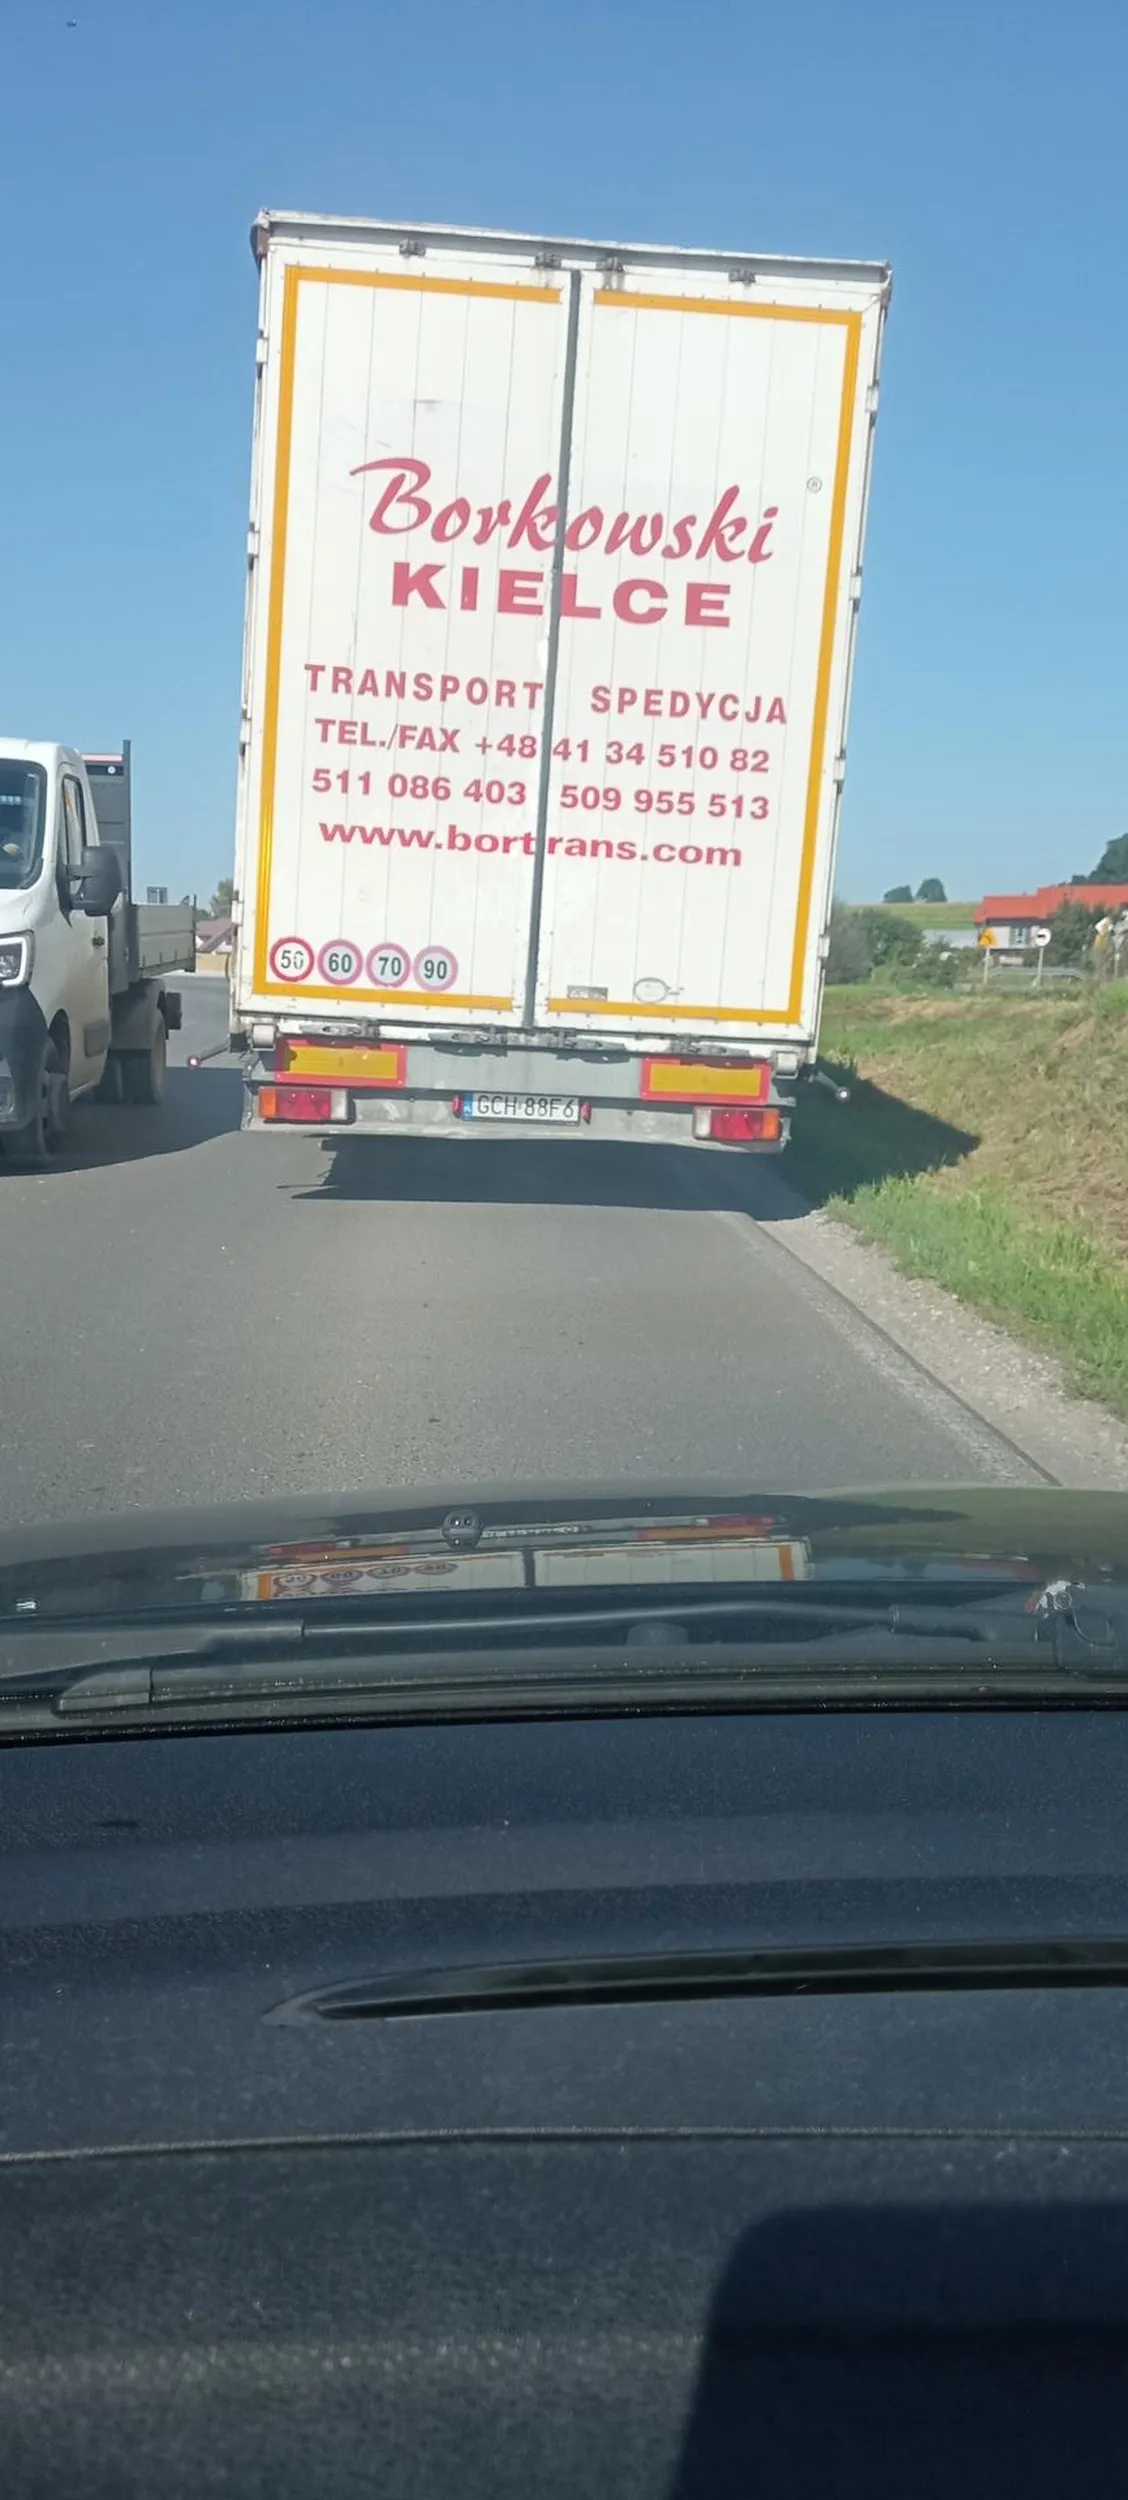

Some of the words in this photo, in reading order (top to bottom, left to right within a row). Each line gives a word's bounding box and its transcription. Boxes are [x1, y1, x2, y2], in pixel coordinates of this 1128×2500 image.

[350, 456, 779, 564] Borkowski
[391, 561, 731, 628] KIELCE
[304, 663, 544, 710] TRANSPORT
[590, 685, 788, 725] SPEDYCJA
[314, 717, 461, 753] TEL./FAX
[474, 734, 538, 760] +48
[552, 737, 589, 763] 41
[605, 740, 646, 766] 34
[656, 744, 720, 770] 510
[729, 748, 770, 774] 82
[311, 768, 372, 796] 511
[387, 773, 453, 802] 086
[462, 778, 528, 807] 403
[559, 784, 623, 812] 509
[633, 788, 696, 816] 955
[708, 793, 770, 821] 513
[318, 821, 744, 868] www.bortrans.com
[280, 949, 304, 970] 50
[328, 952, 352, 973] 60
[377, 956, 402, 977] 70
[423, 959, 448, 980] 90
[477, 1094, 517, 1116] GCH
[524, 1097, 575, 1118] 88F6
